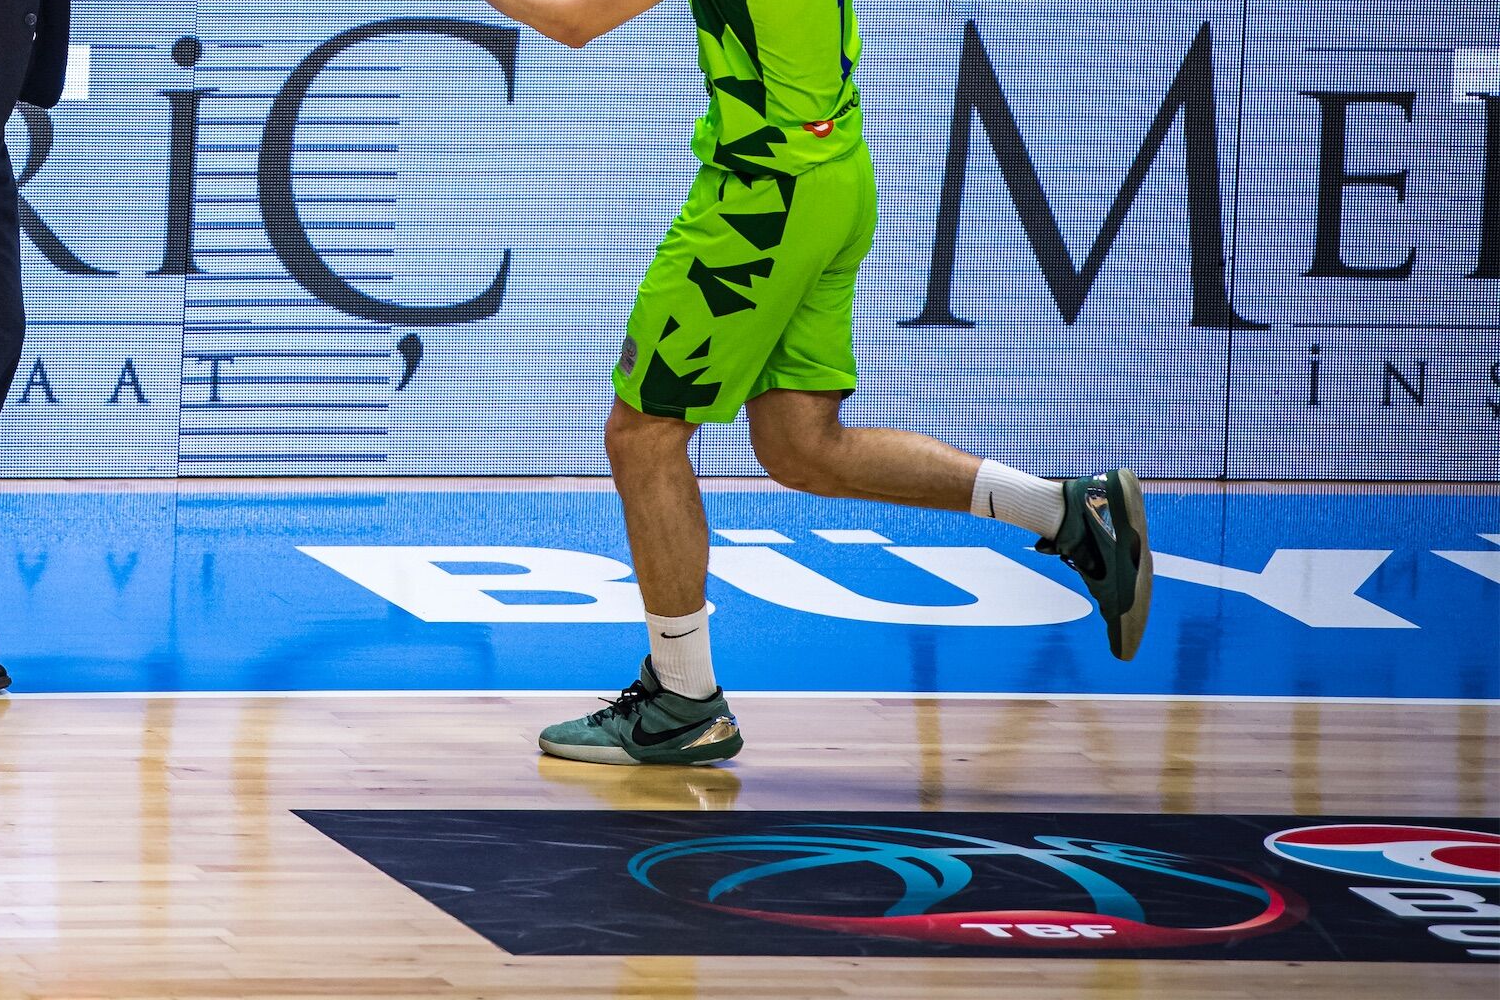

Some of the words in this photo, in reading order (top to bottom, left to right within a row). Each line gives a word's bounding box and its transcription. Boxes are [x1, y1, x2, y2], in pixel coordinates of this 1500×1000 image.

[897, 20, 1500, 331] ME
[296, 528, 1500, 630] BÜY
[960, 923, 1117, 939] TBF
